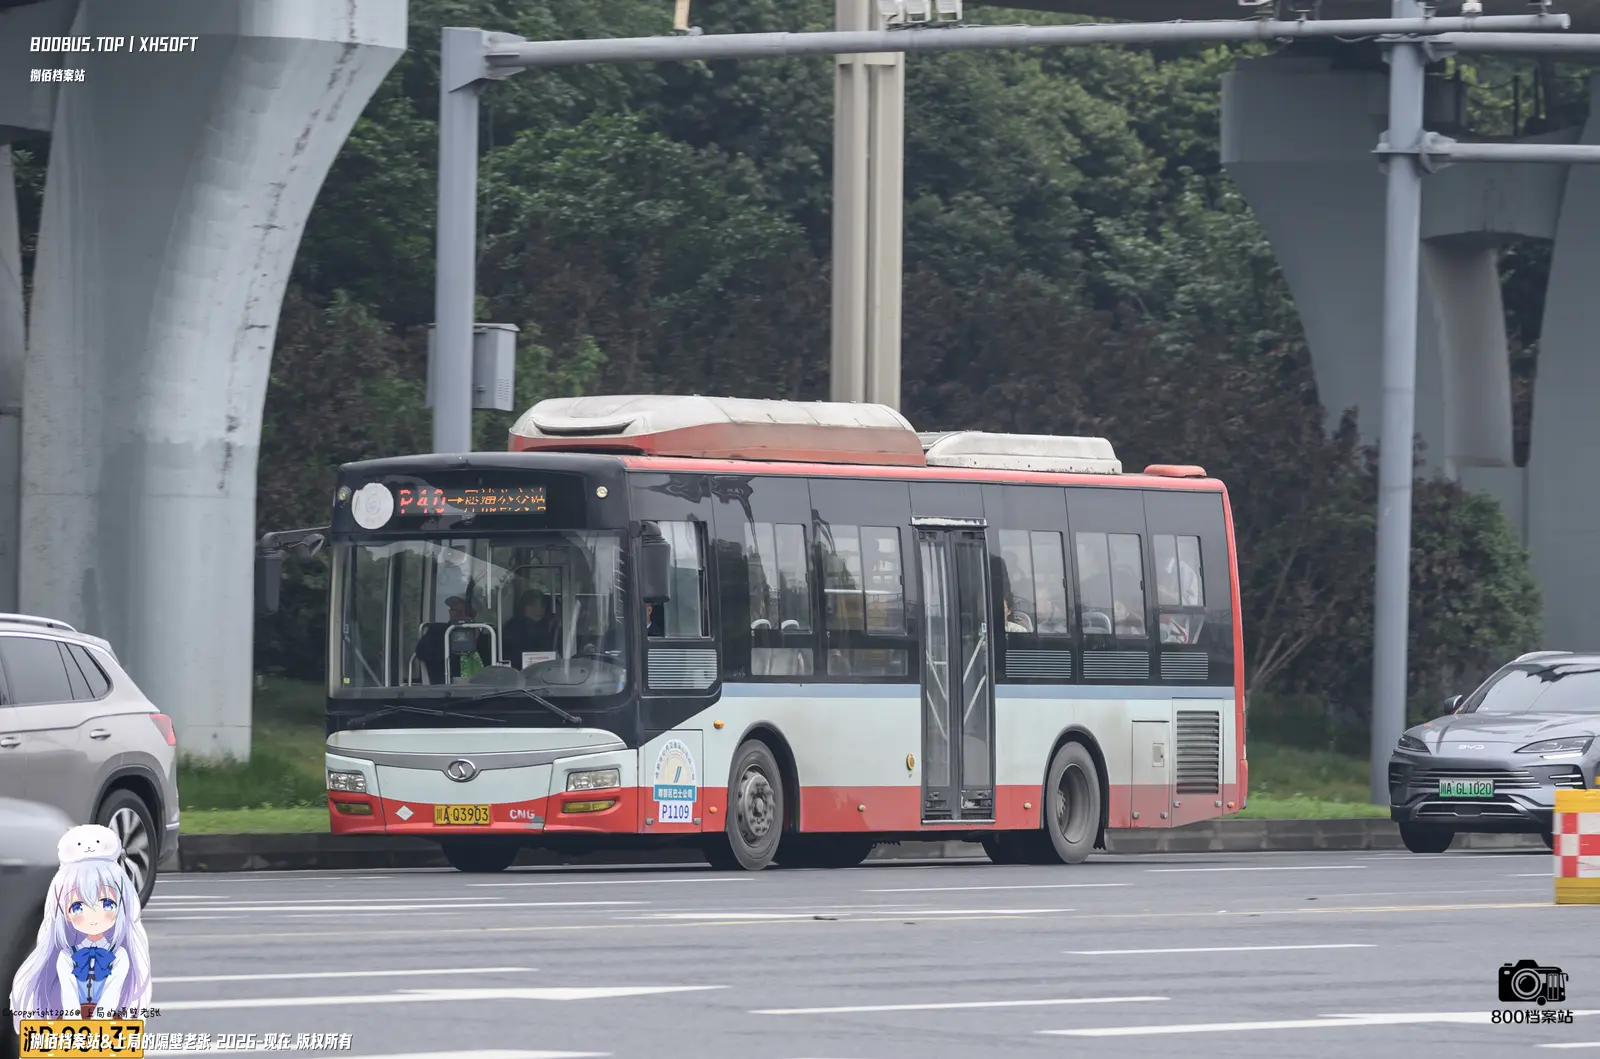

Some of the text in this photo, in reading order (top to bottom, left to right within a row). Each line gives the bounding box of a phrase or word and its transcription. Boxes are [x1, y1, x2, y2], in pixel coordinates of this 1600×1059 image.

[399, 488, 446, 514] P40
[509, 808, 536, 819] CNG
[661, 804, 690, 819] P1109
